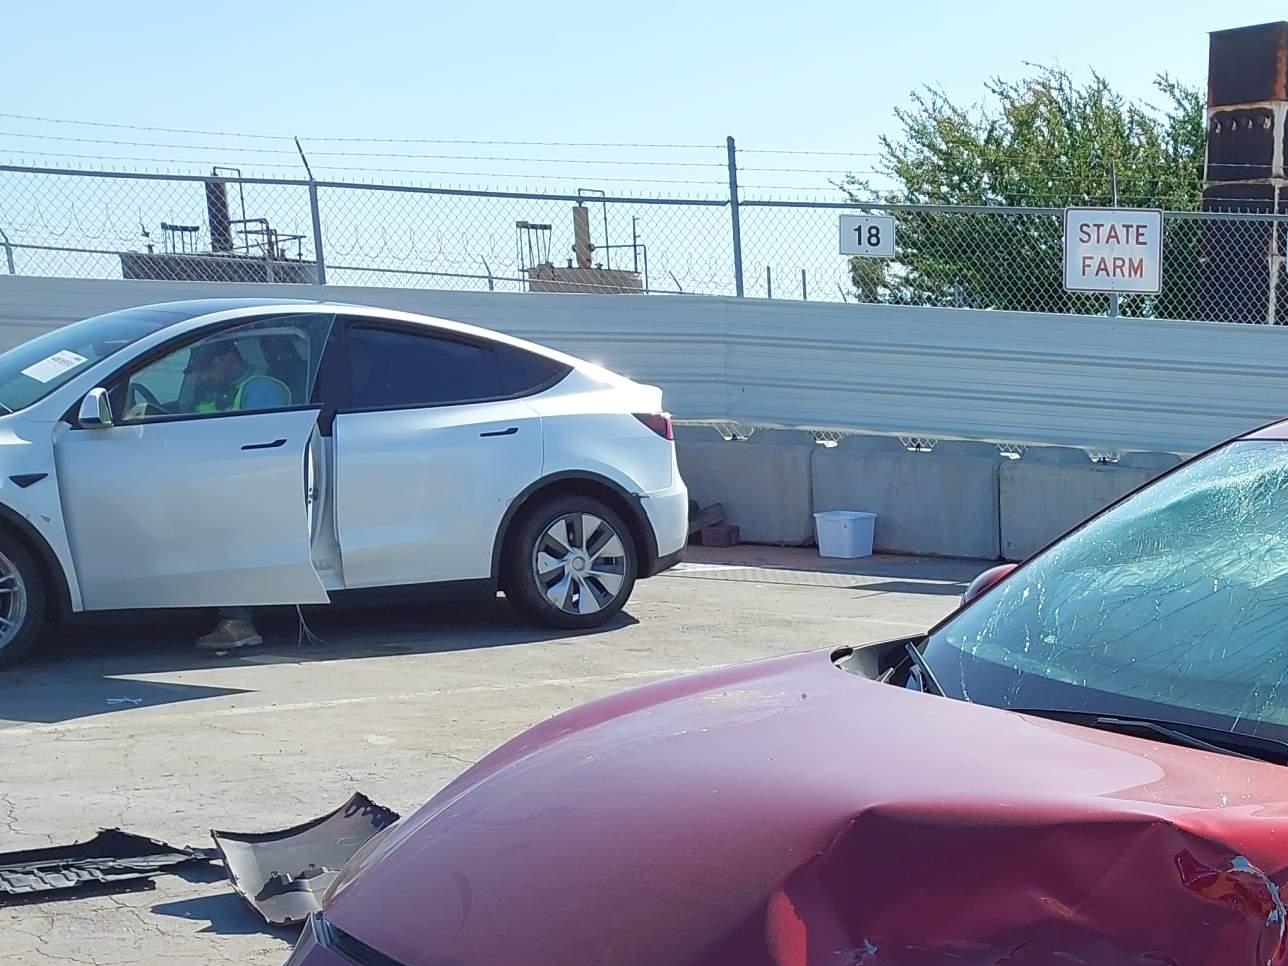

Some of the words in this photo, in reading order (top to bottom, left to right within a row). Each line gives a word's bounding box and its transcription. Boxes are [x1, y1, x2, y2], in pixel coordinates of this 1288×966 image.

[853, 224, 881, 247] 18
[1079, 223, 1148, 245] STATE
[1081, 256, 1144, 278] FARM
